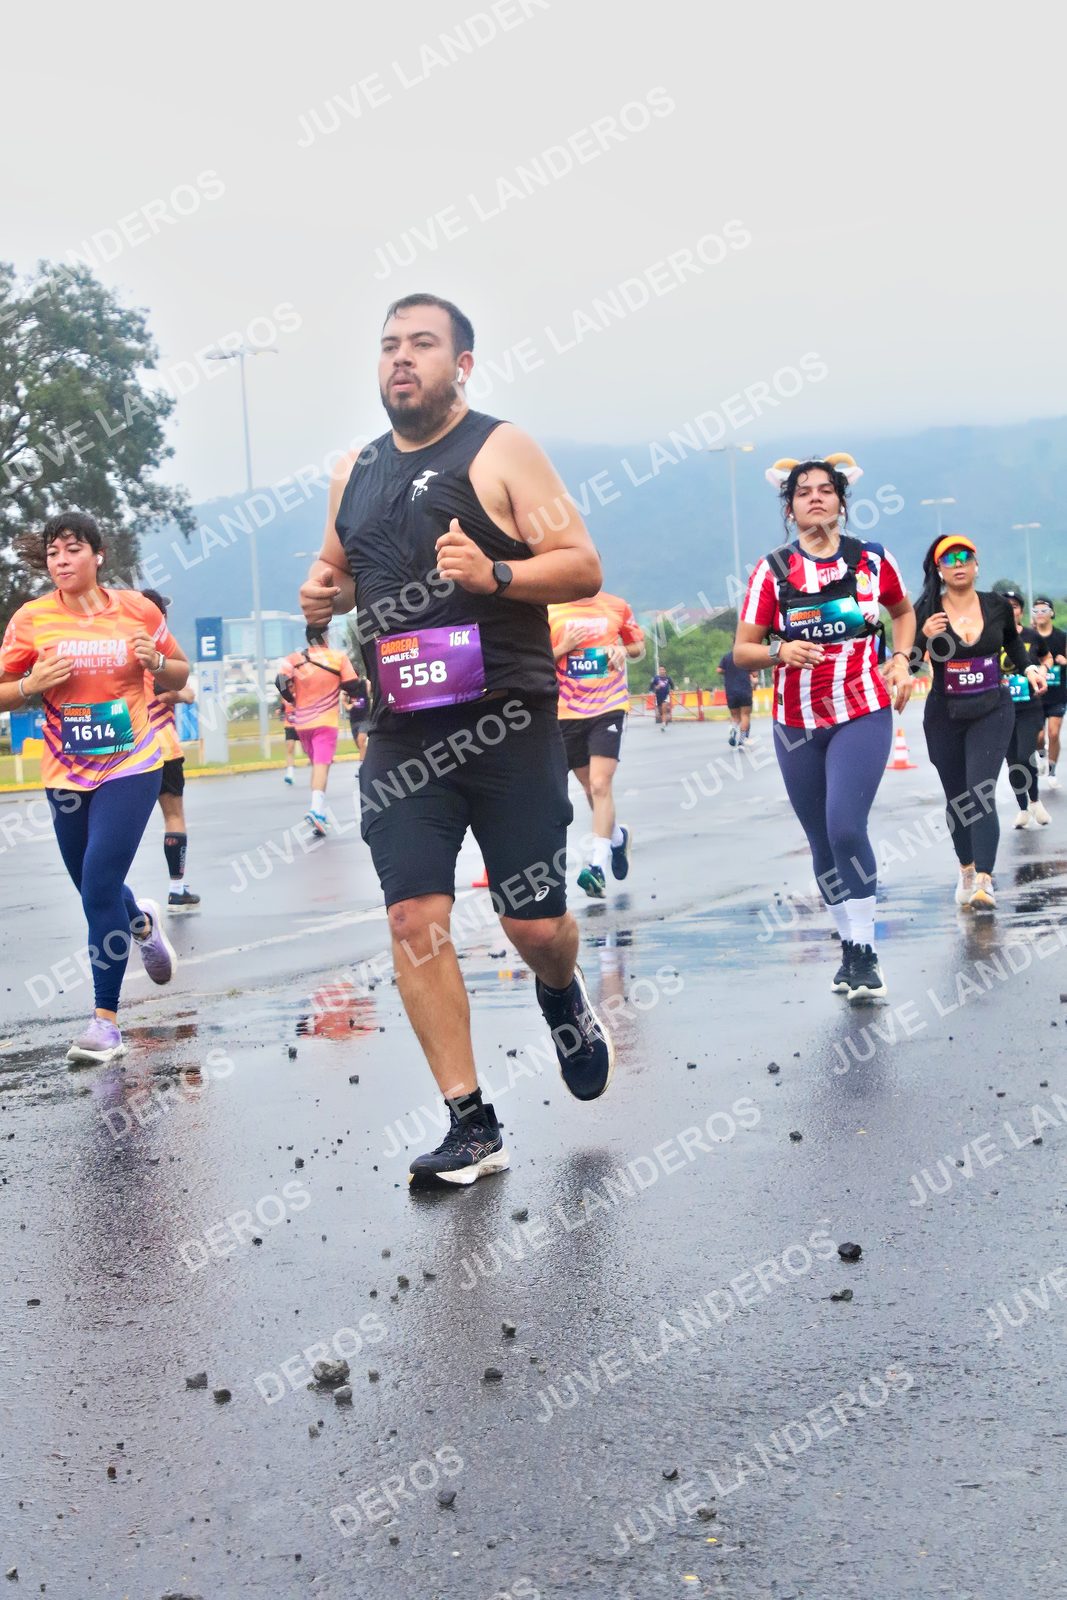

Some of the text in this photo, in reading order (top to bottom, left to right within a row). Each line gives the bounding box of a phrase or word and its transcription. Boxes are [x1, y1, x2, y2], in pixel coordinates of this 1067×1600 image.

[801, 621, 847, 639] 1430
[57, 639, 127, 657] CARRERA
[201, 635, 217, 657] E
[381, 637, 419, 656] CARRERA
[73, 656, 113, 669] MNILIFE
[571, 660, 598, 671] 1401
[399, 660, 448, 689] 558
[958, 672, 984, 685] 599
[71, 724, 116, 741] 1614
